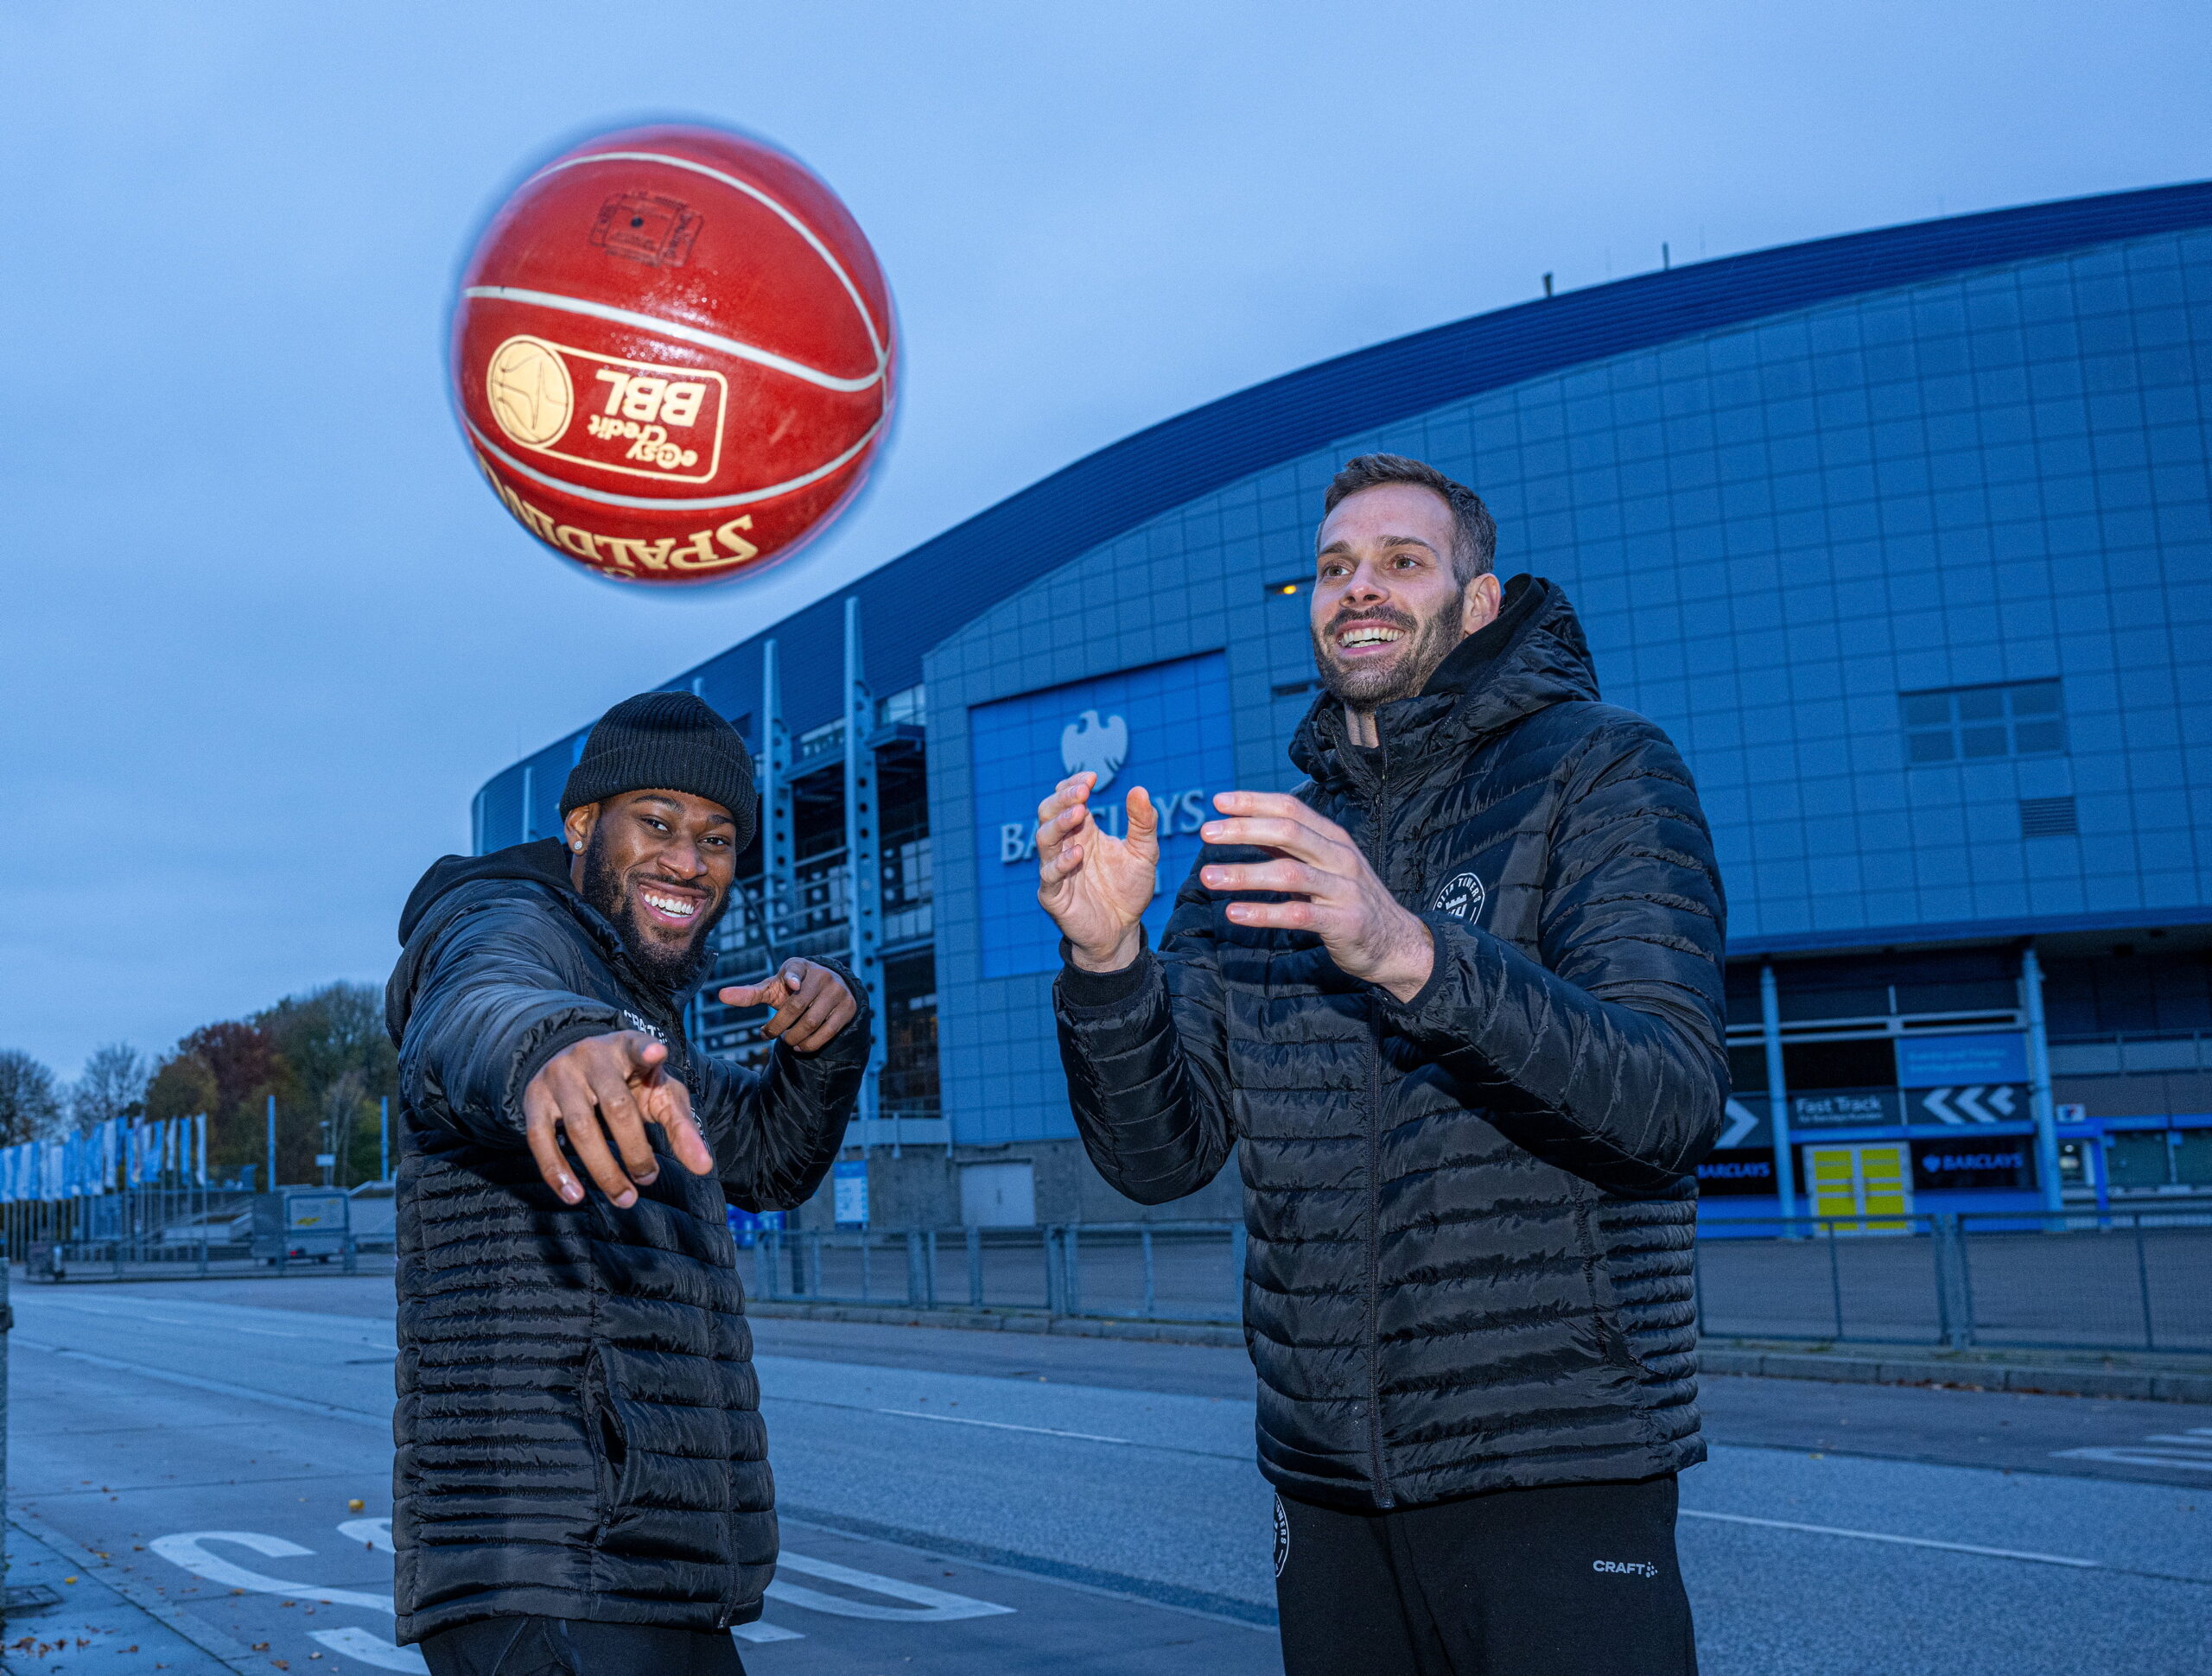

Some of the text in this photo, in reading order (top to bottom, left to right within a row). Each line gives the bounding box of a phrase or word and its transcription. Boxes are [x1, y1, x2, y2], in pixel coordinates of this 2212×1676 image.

[595, 369, 707, 427] BBL
[587, 414, 668, 448] Credit
[476, 451, 759, 571] SPALDIN
[1796, 1094, 1882, 1114] Fast Track
[1697, 1162, 1770, 1179] BARCLAYS
[1942, 1152, 2024, 1171] BARCLAYS
[1592, 1559, 1646, 1575] CRAFT
